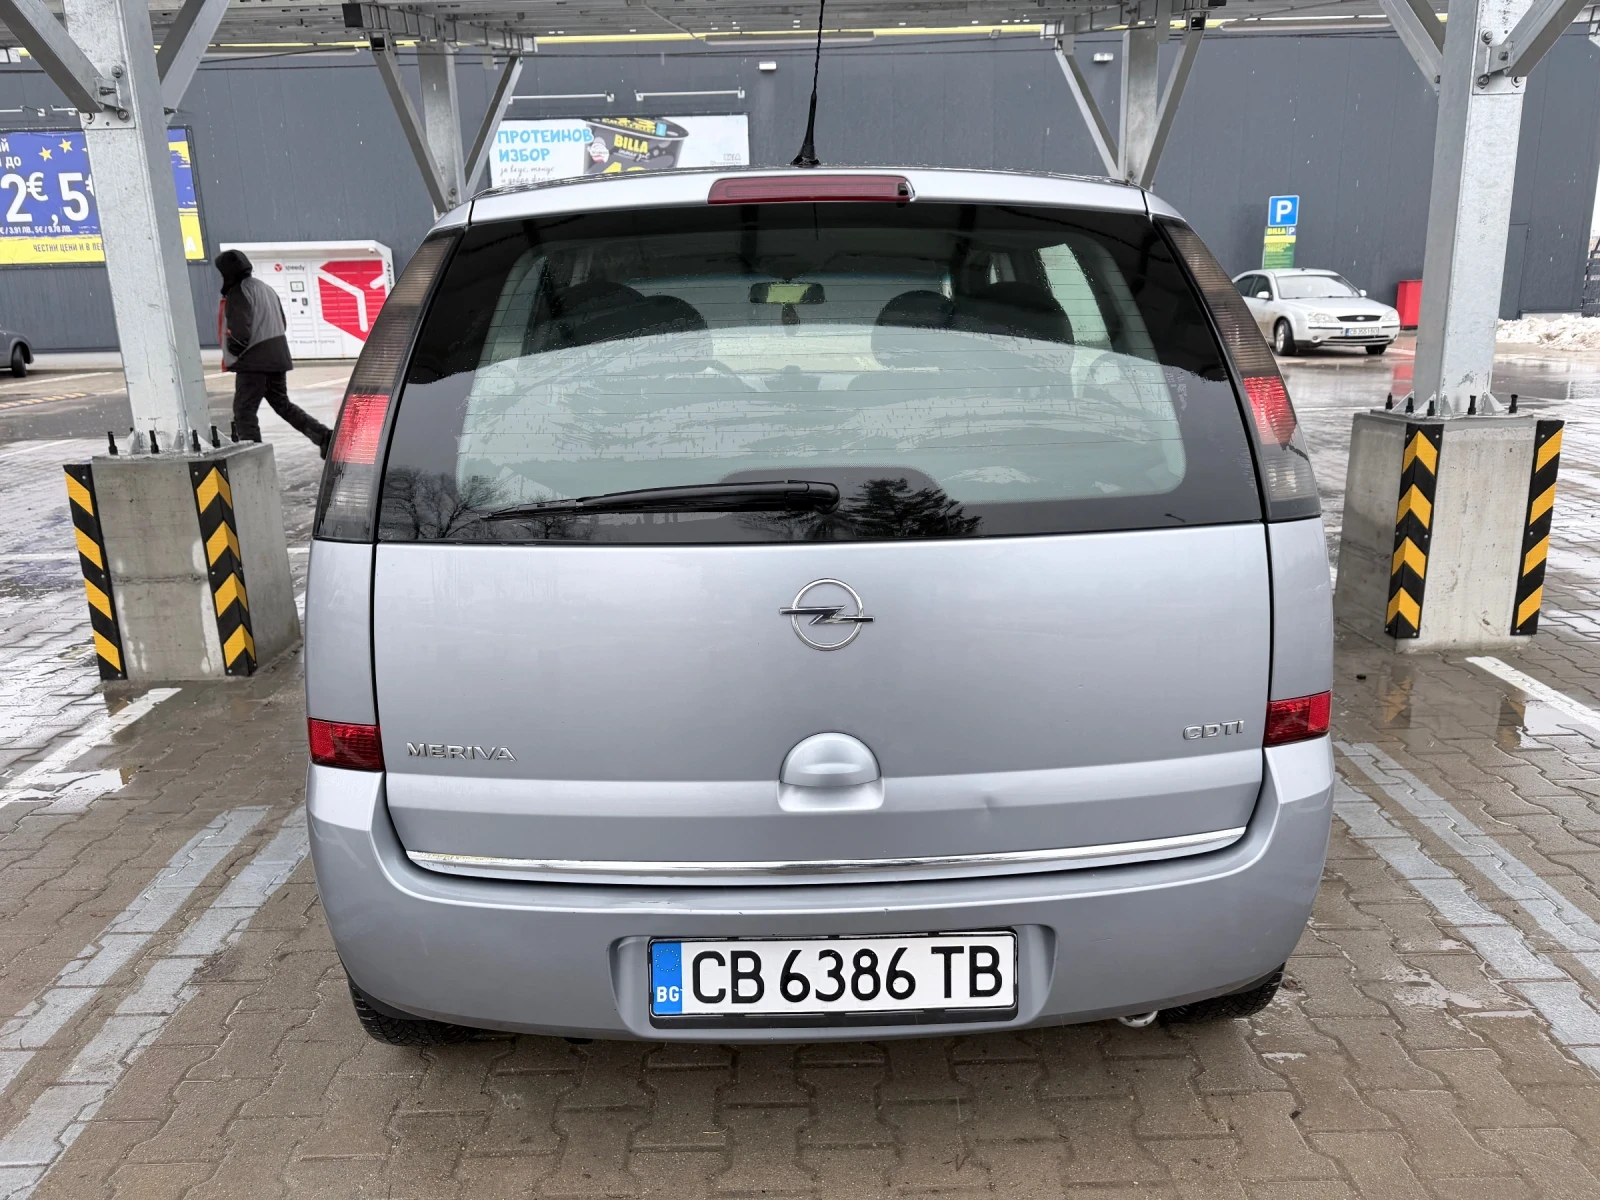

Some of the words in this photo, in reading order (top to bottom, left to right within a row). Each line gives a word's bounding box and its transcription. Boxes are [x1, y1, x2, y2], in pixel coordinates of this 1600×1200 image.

[497, 127, 594, 144] ПРОТЕИНОВ
[613, 134, 649, 154] BILLA
[5, 156, 22, 169] до
[499, 148, 551, 163] ИЗБОР
[1275, 200, 1293, 223] P
[1288, 227, 1296, 235] P
[33, 243, 58, 253] ЧЕСТНИ
[60, 243, 77, 253] ЦЕНИ
[79, 243, 84, 252] И
[285, 263, 306, 272] speedy
[1183, 719, 1245, 740] CDTI
[406, 742, 517, 762] MERIVA
[692, 950, 765, 1004] CB
[779, 947, 916, 1003] 6386
[931, 945, 1003, 999] TB
[656, 986, 680, 1003] BG
